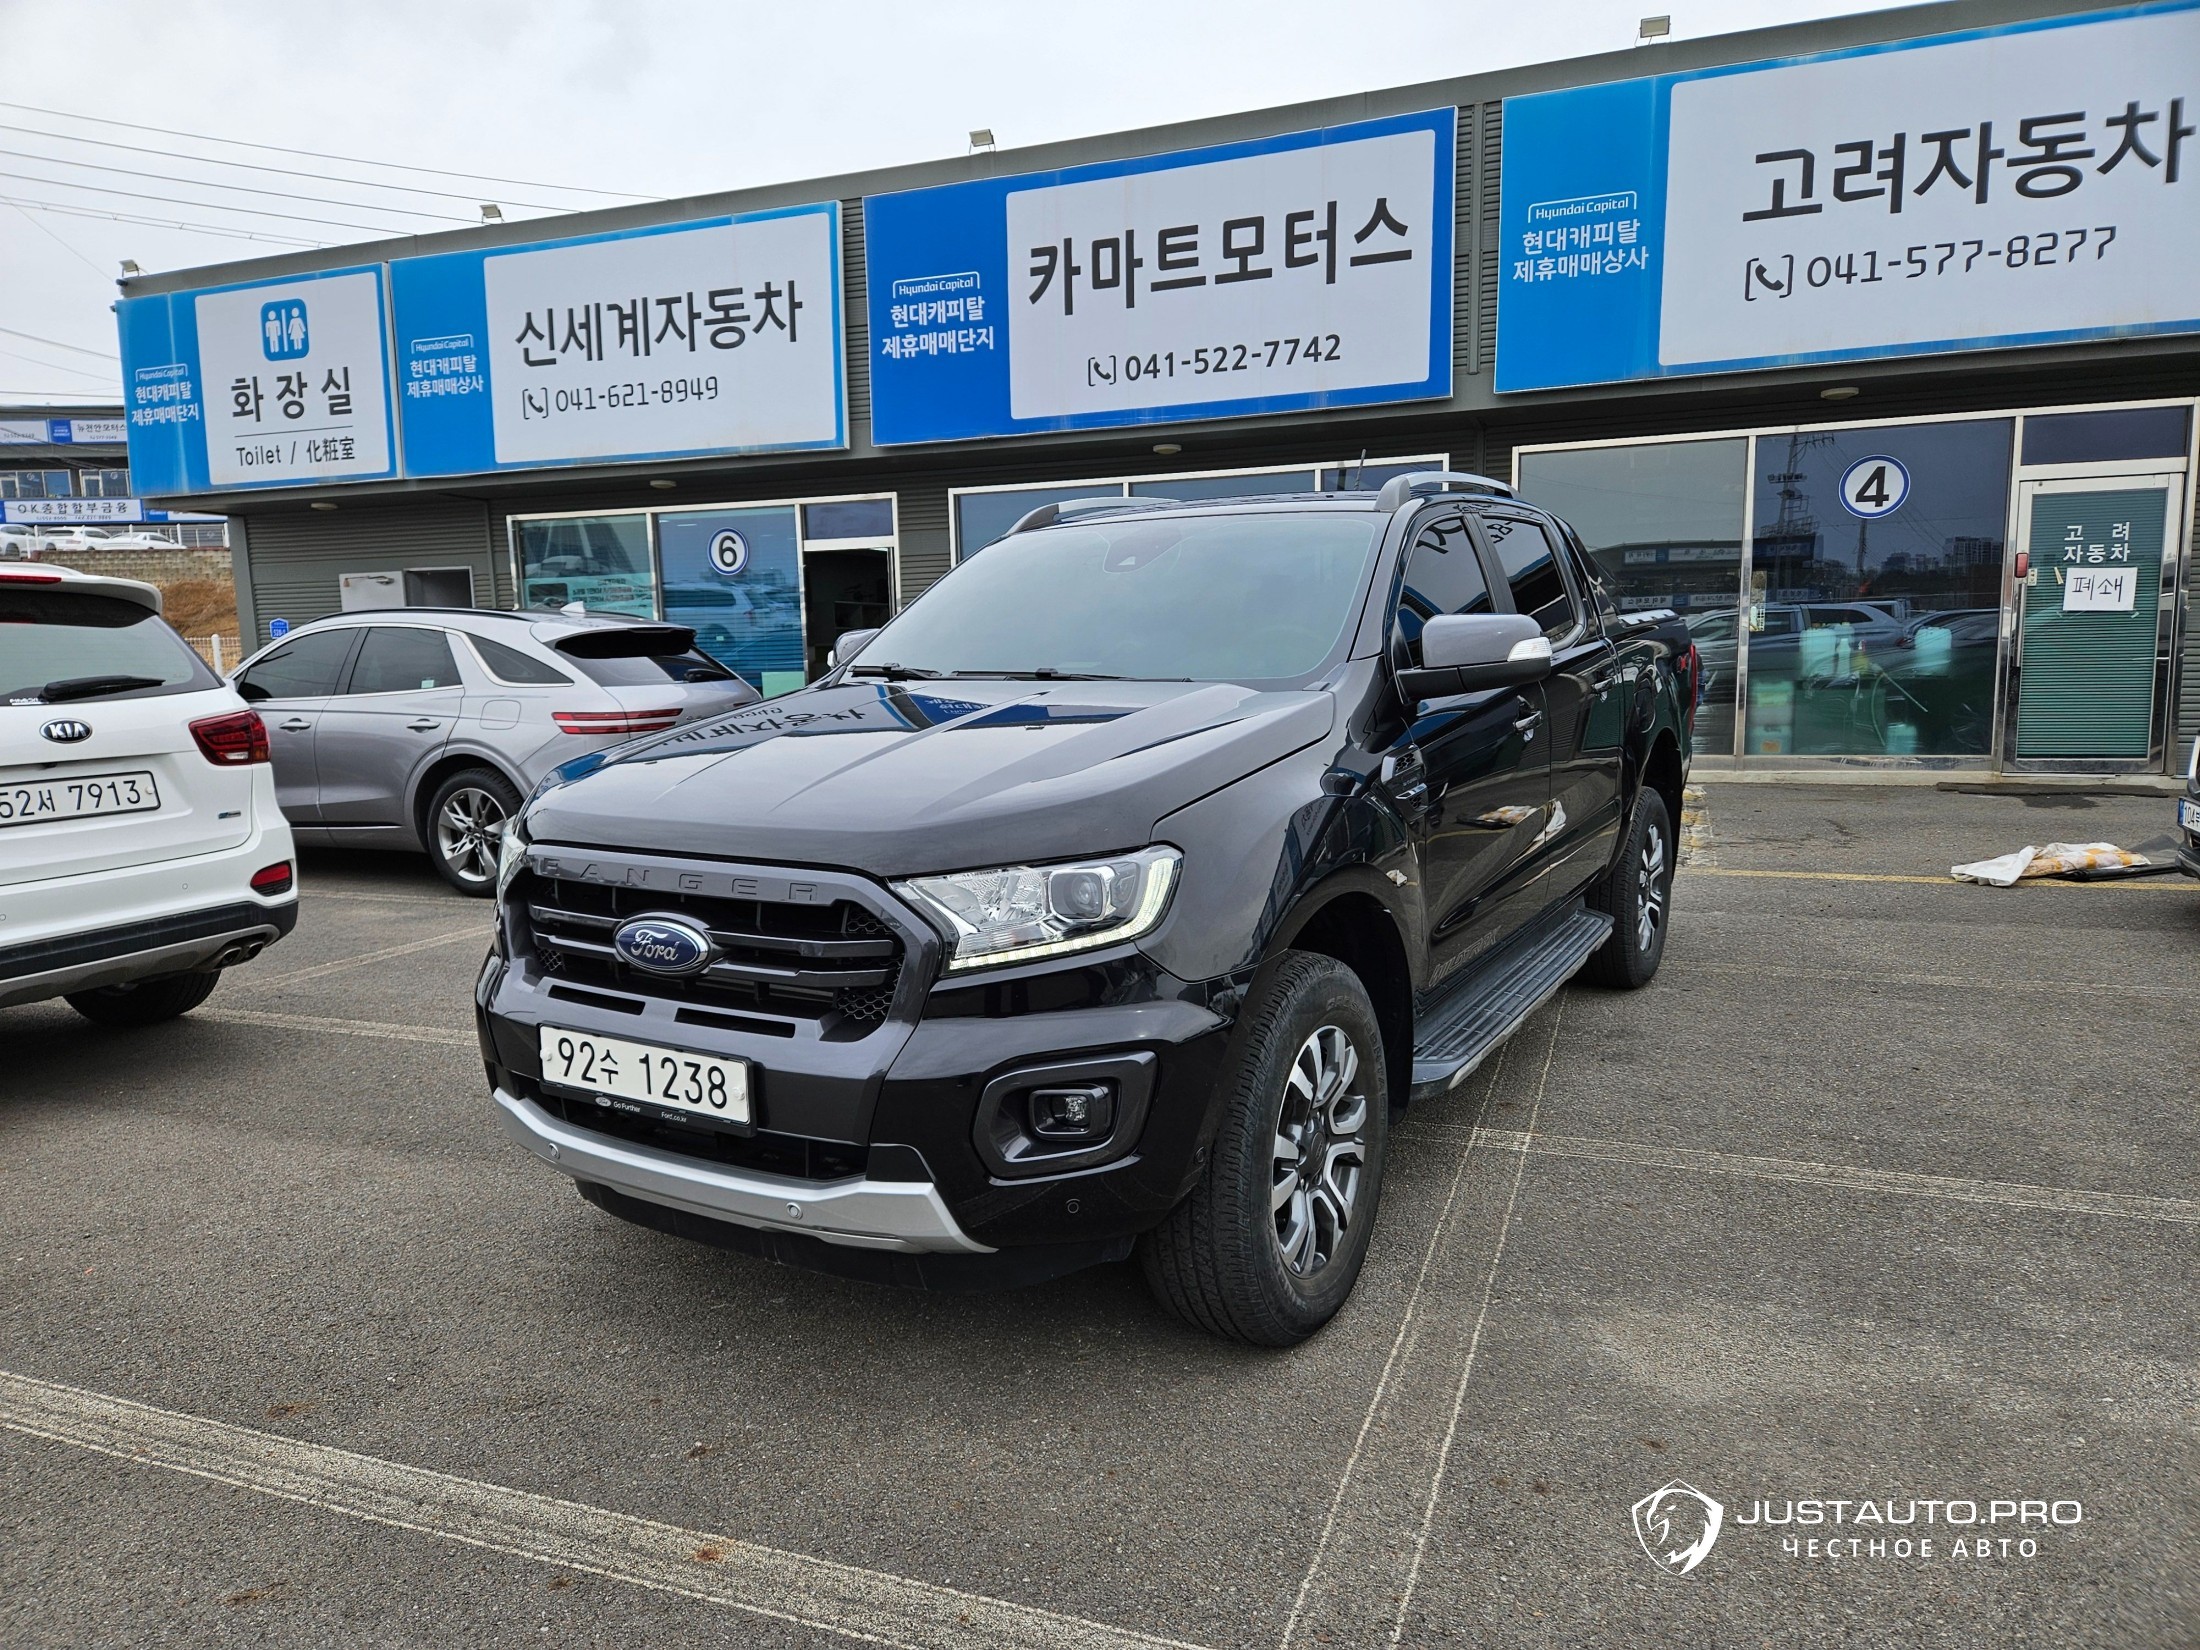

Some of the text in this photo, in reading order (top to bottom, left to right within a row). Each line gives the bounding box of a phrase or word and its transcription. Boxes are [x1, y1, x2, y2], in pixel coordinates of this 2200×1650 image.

[1742, 96, 2197, 222] 고려자동차
[1535, 196, 1629, 220] Hyundai Capital
[1523, 218, 1641, 255] 현대캐피탈
[1029, 197, 1413, 316] 카마트모터스
[1513, 245, 1649, 283] 제휴매매상사
[1807, 226, 2117, 288] 041-577-8277
[898, 276, 974, 296] Hyundai Capital
[515, 279, 803, 368] 신세계자동차
[890, 295, 985, 328] 현대캐피탈
[416, 338, 468, 352] Hyundai Capital
[882, 325, 994, 359] 제휴매매단지
[1125, 333, 1341, 382] 041-522-7742
[410, 354, 476, 378] 현대캐피탈
[135, 381, 192, 404] 현대캐피탈
[231, 366, 352, 423] 화장실
[407, 375, 483, 398] 제휴매매상사
[556, 376, 718, 412] 041-621-8949
[131, 403, 199, 426] 제휴매매단지
[236, 445, 281, 467] Toilet
[306, 436, 355, 464] 化粧室
[1855, 466, 1889, 507] 4
[718, 534, 737, 567] 6
[2063, 543, 2130, 563] 자동차
[2072, 574, 2124, 602] 폐쇄
[49, 722, 86, 738] KIA
[67, 779, 142, 811] 7913
[541, 857, 819, 901] RANGER
[631, 929, 681, 960] Ford
[558, 1037, 727, 1109] 92수 1238
[613, 1101, 621, 1109] Go
[621, 1102, 641, 1113] Further
